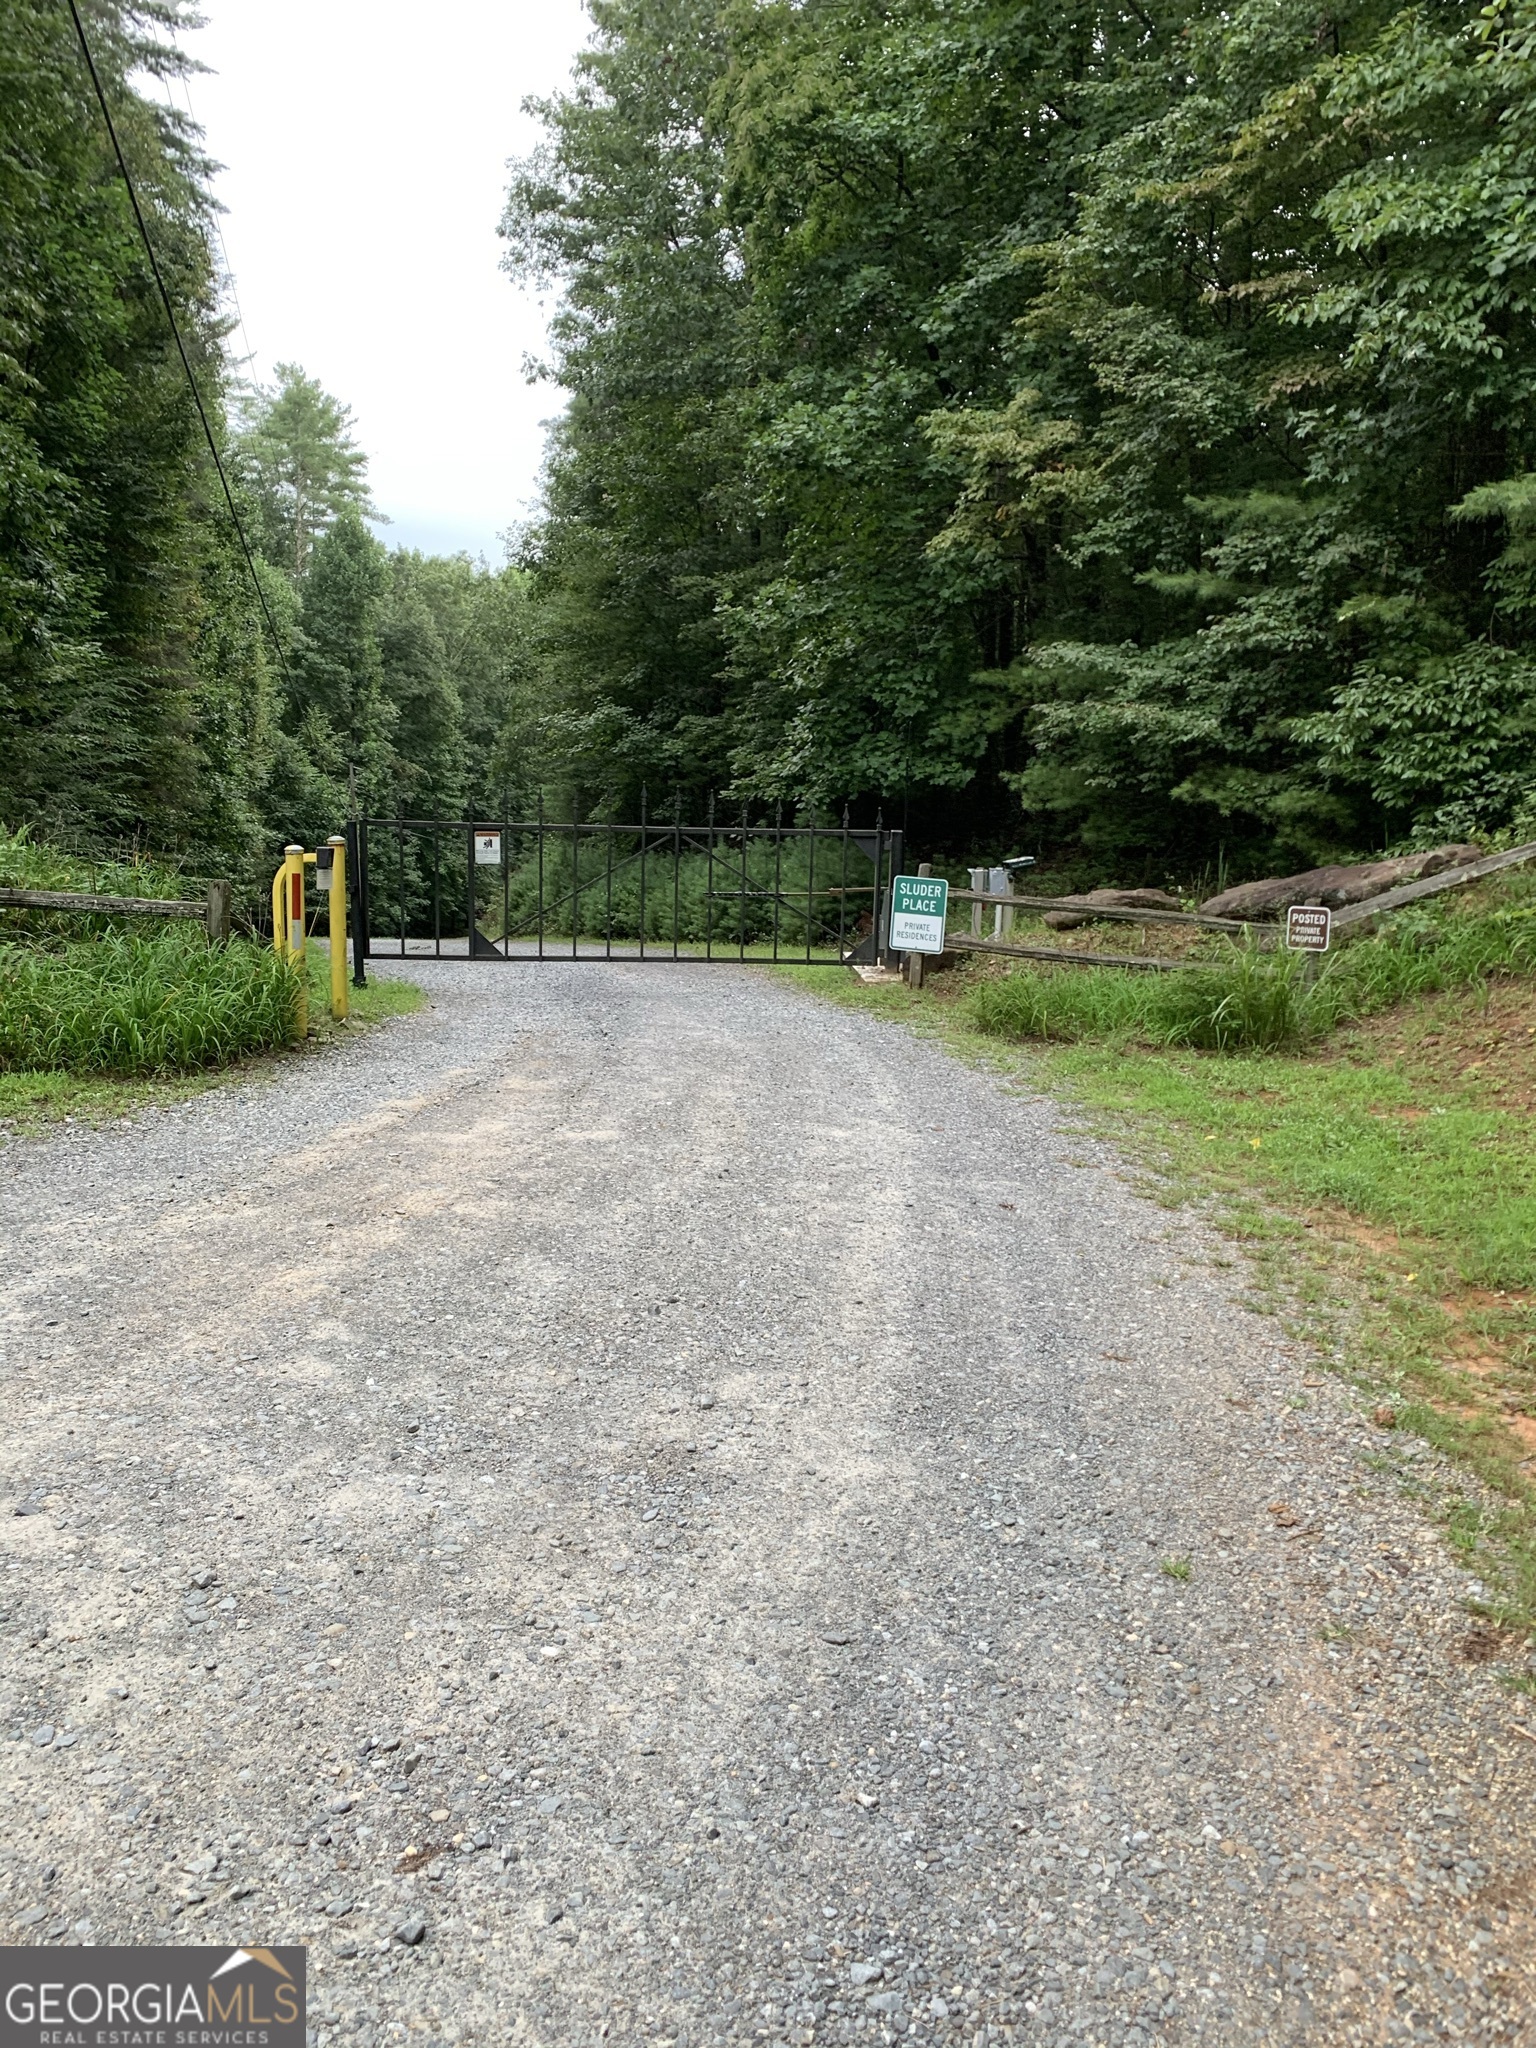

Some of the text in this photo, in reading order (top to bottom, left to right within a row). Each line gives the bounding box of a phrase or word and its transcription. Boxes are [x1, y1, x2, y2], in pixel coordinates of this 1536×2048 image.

[900, 883, 941, 897] SLUDER
[903, 898, 936, 912] PLACE
[1292, 913, 1325, 925] POSTED
[904, 922, 930, 931] PRIVATE
[1296, 926, 1321, 935] PRIVATE
[897, 931, 937, 941] RESIDENCES
[1292, 935, 1324, 944] PROPERTY
